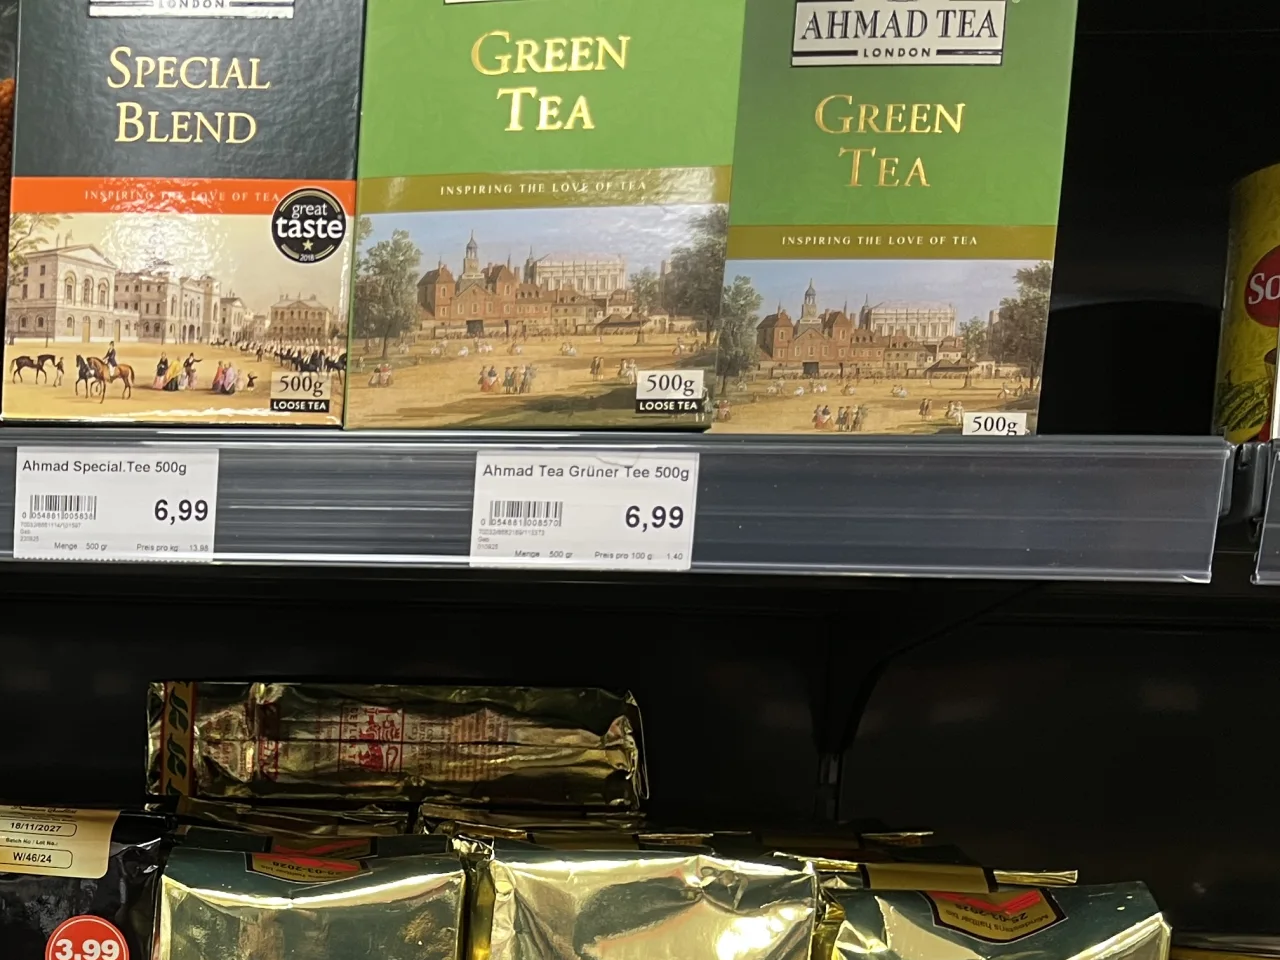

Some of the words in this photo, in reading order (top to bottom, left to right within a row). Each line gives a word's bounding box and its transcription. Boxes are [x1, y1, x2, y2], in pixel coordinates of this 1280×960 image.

[800, 10, 929, 42] AHMAD
[936, 8, 998, 40] TEA
[471, 30, 631, 76] GREEN
[863, 47, 931, 58] LONDON
[107, 45, 270, 91] SPECIAL
[496, 86, 595, 132] TEA
[813, 93, 966, 136] GREEN
[116, 102, 257, 145] BLEND
[838, 146, 931, 189] TEA
[292, 203, 327, 220] great
[275, 217, 343, 239] taste
[782, 236, 851, 246] INSPIRING
[858, 236, 882, 246] THE
[888, 236, 924, 246] LOVE
[929, 236, 947, 246] OF
[952, 236, 978, 246] TEA
[278, 374, 324, 398] 500g
[645, 372, 695, 399] 500g
[273, 400, 303, 411] LOOSE
[306, 400, 327, 411] TEA
[970, 413, 1019, 436] 500g
[22, 459, 69, 472] Ahmad
[154, 461, 187, 476] 500g
[482, 464, 533, 477] Ahmad
[539, 465, 564, 477] Tea
[569, 464, 619, 478] Grüner
[624, 466, 650, 478] Tee
[654, 466, 690, 481] 500g
[154, 498, 208, 525] 6,99
[625, 505, 684, 532] 6,99
[9, 820, 63, 834] 18/11/2027
